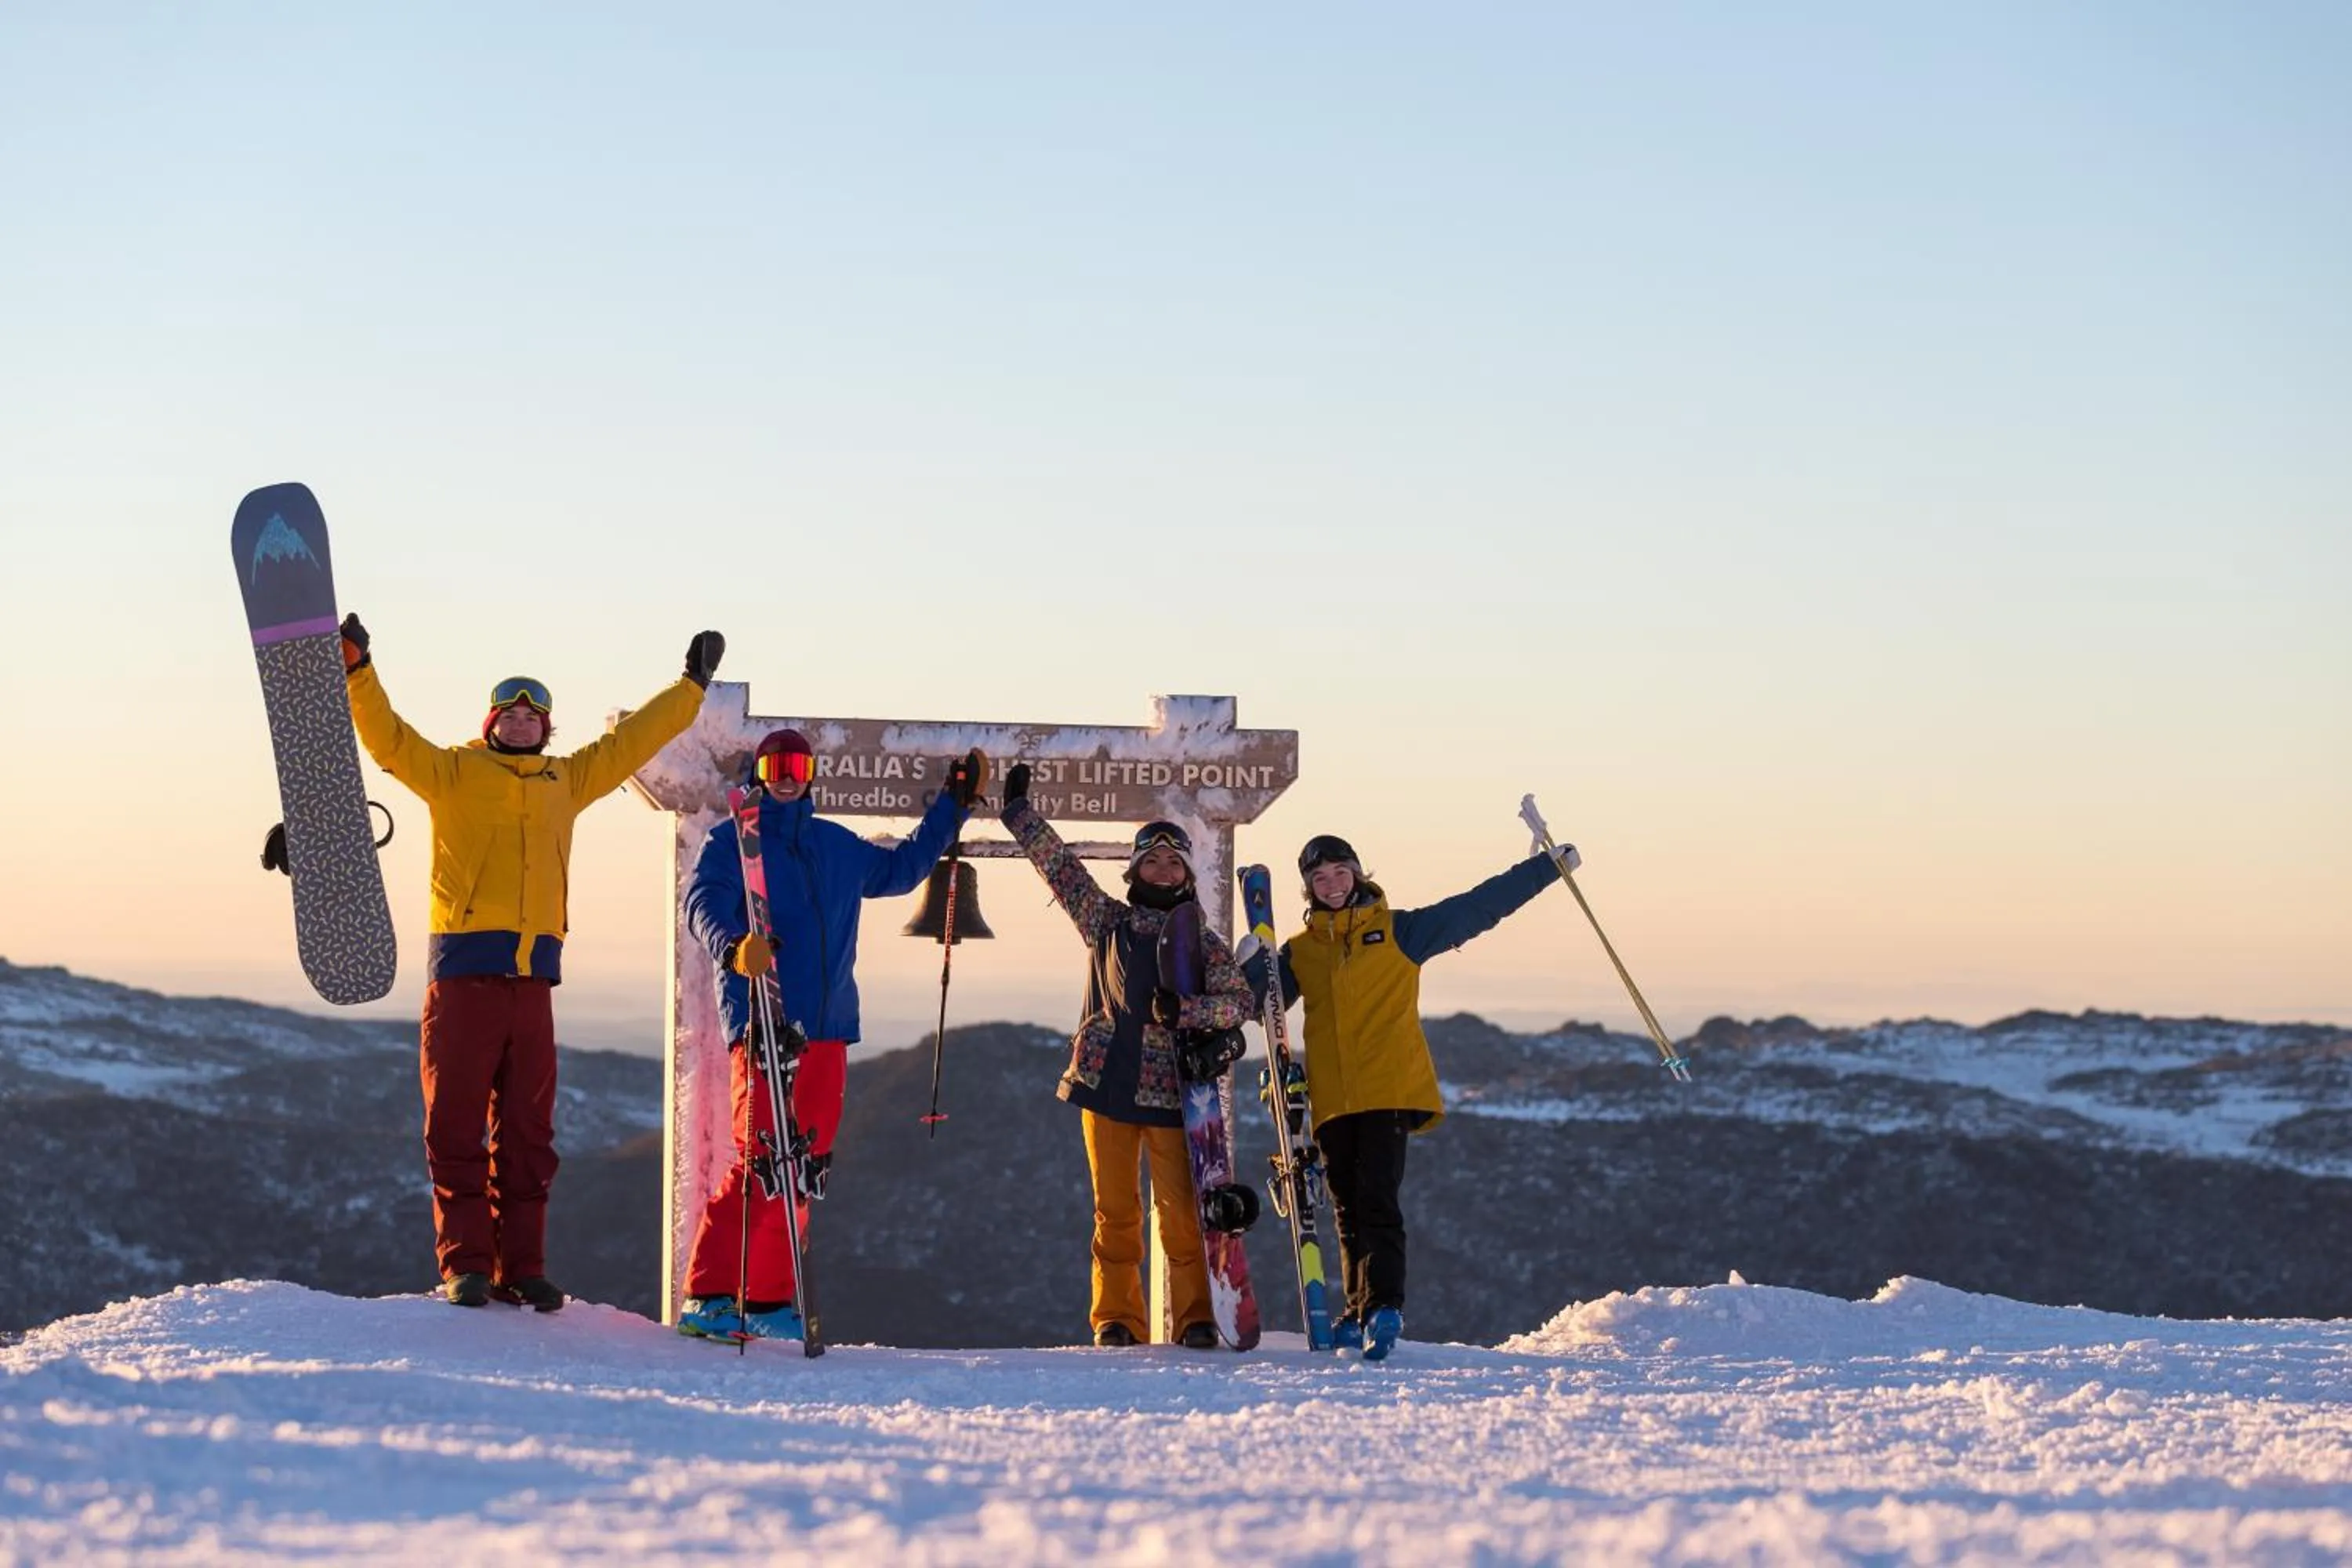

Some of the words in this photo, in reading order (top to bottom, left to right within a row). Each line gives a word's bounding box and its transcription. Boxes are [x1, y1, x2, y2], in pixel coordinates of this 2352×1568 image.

[815, 754, 927, 780] RALIA'S
[1078, 761, 1172, 786] LIFTED
[1182, 764, 1275, 789] POINT
[810, 786, 913, 808] Thredbo
[1071, 792, 1116, 814] Bell
